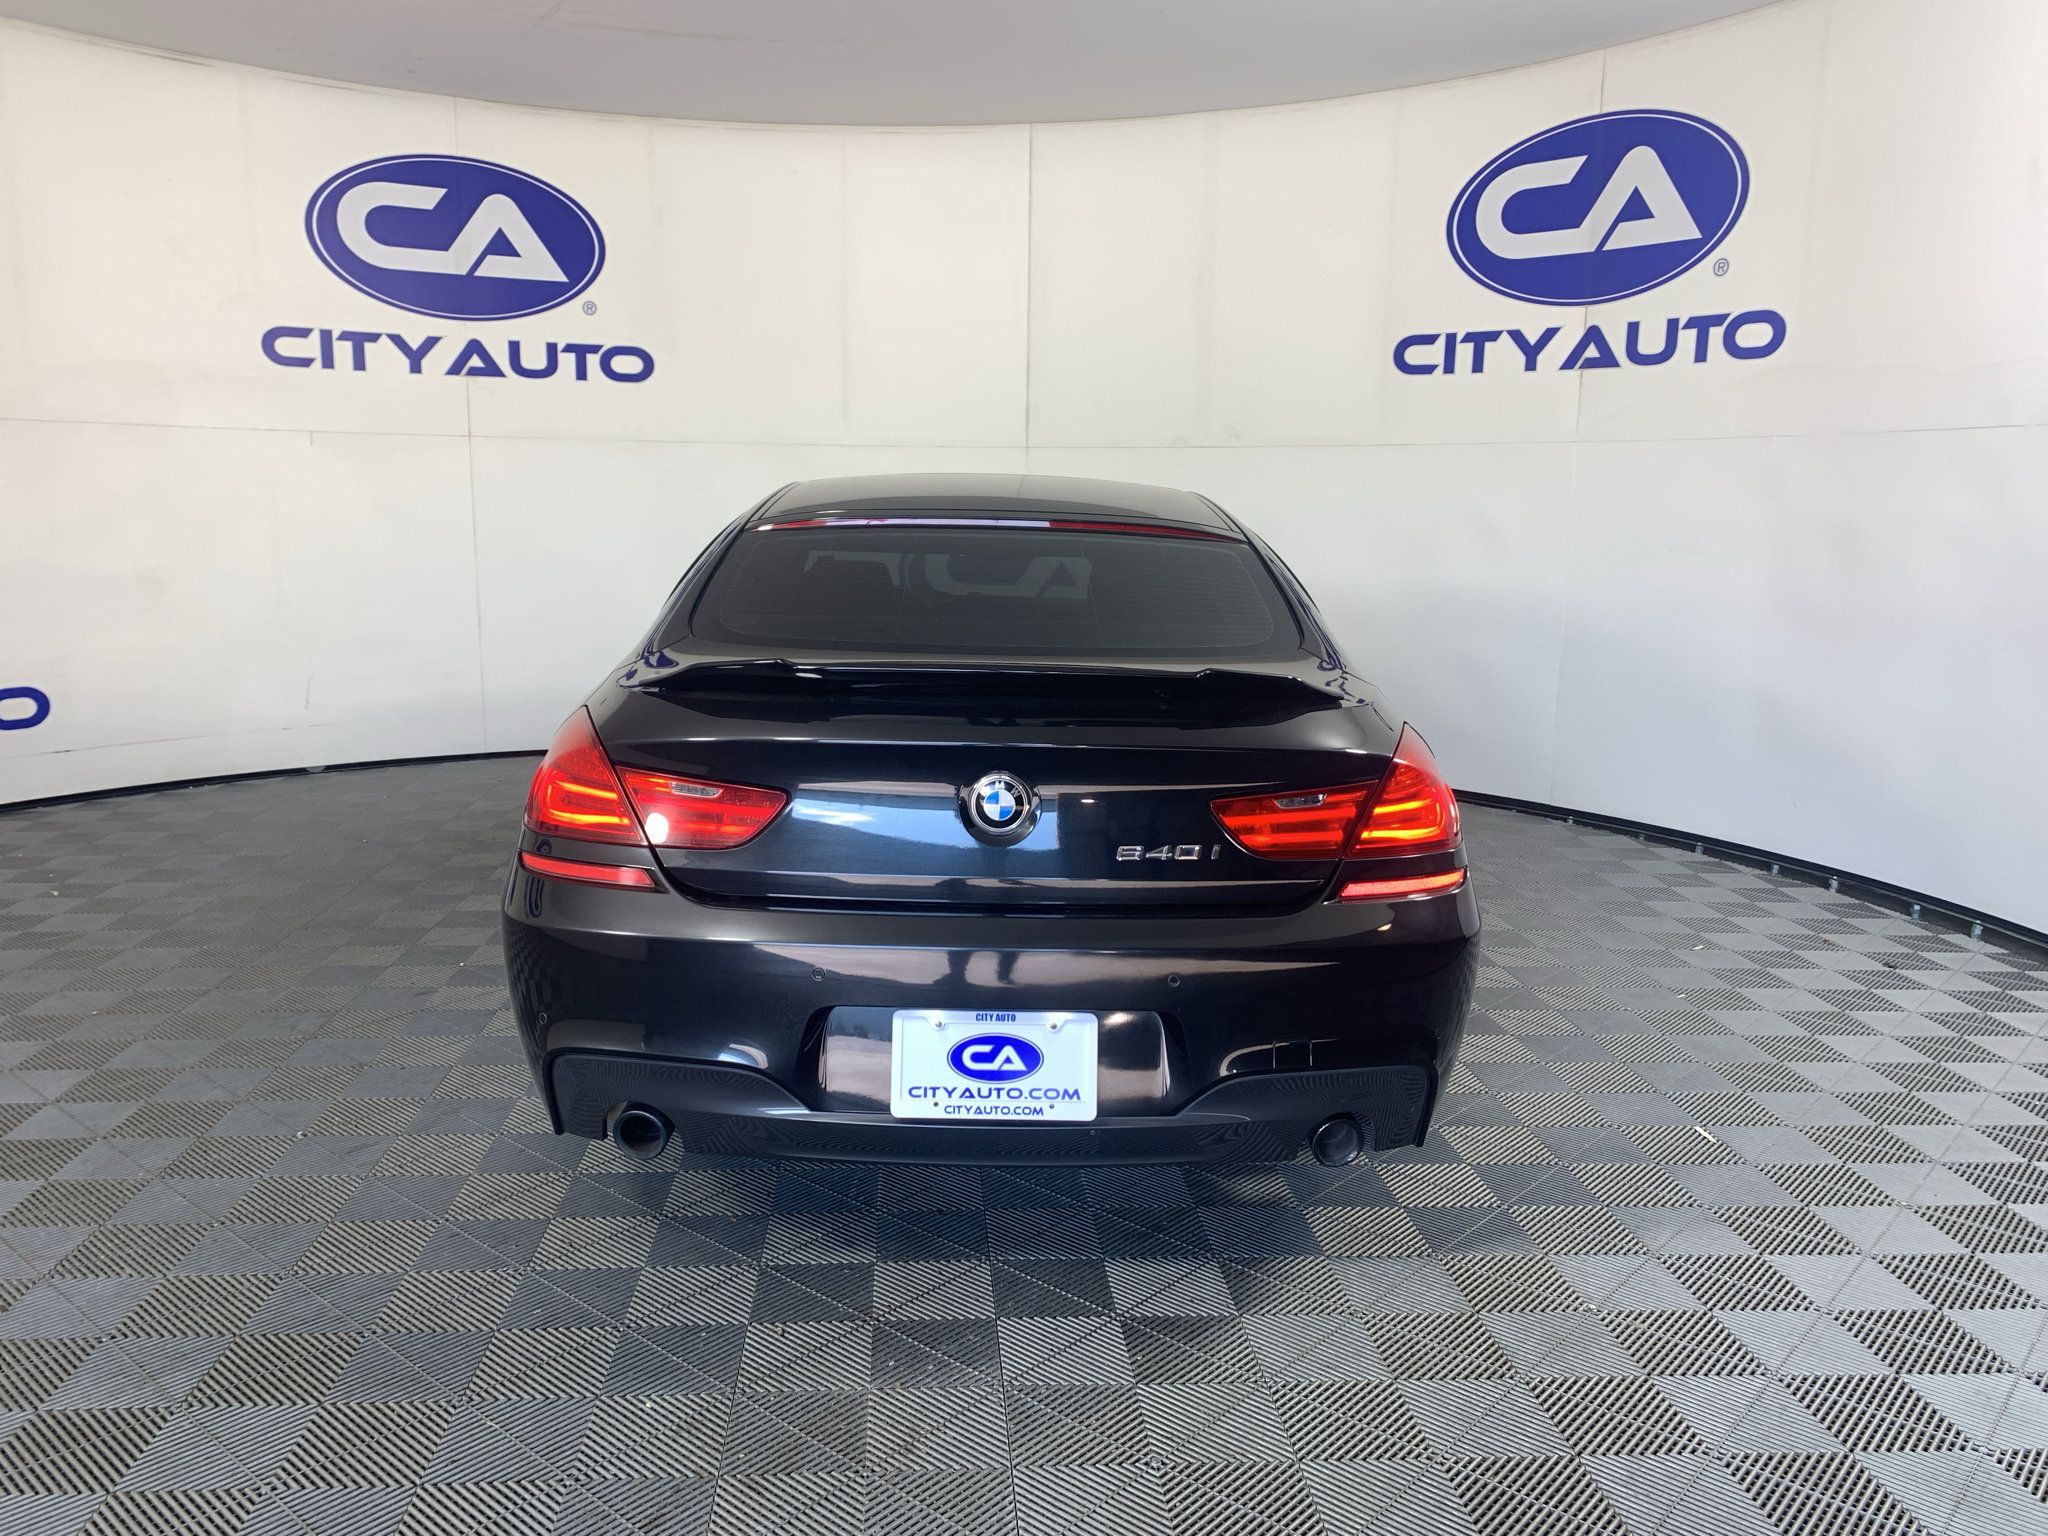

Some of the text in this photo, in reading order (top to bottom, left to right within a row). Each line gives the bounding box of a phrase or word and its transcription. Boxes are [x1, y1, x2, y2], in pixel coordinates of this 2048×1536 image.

[1475, 145, 1703, 260] CA
[336, 181, 569, 283] CA
[975, 1013, 1016, 1023] CITY AUTO
[962, 1044, 1029, 1071] CA
[908, 1086, 1081, 1101] CITYAUTO.COM
[944, 1104, 1044, 1116] CITYAUTO.COM
